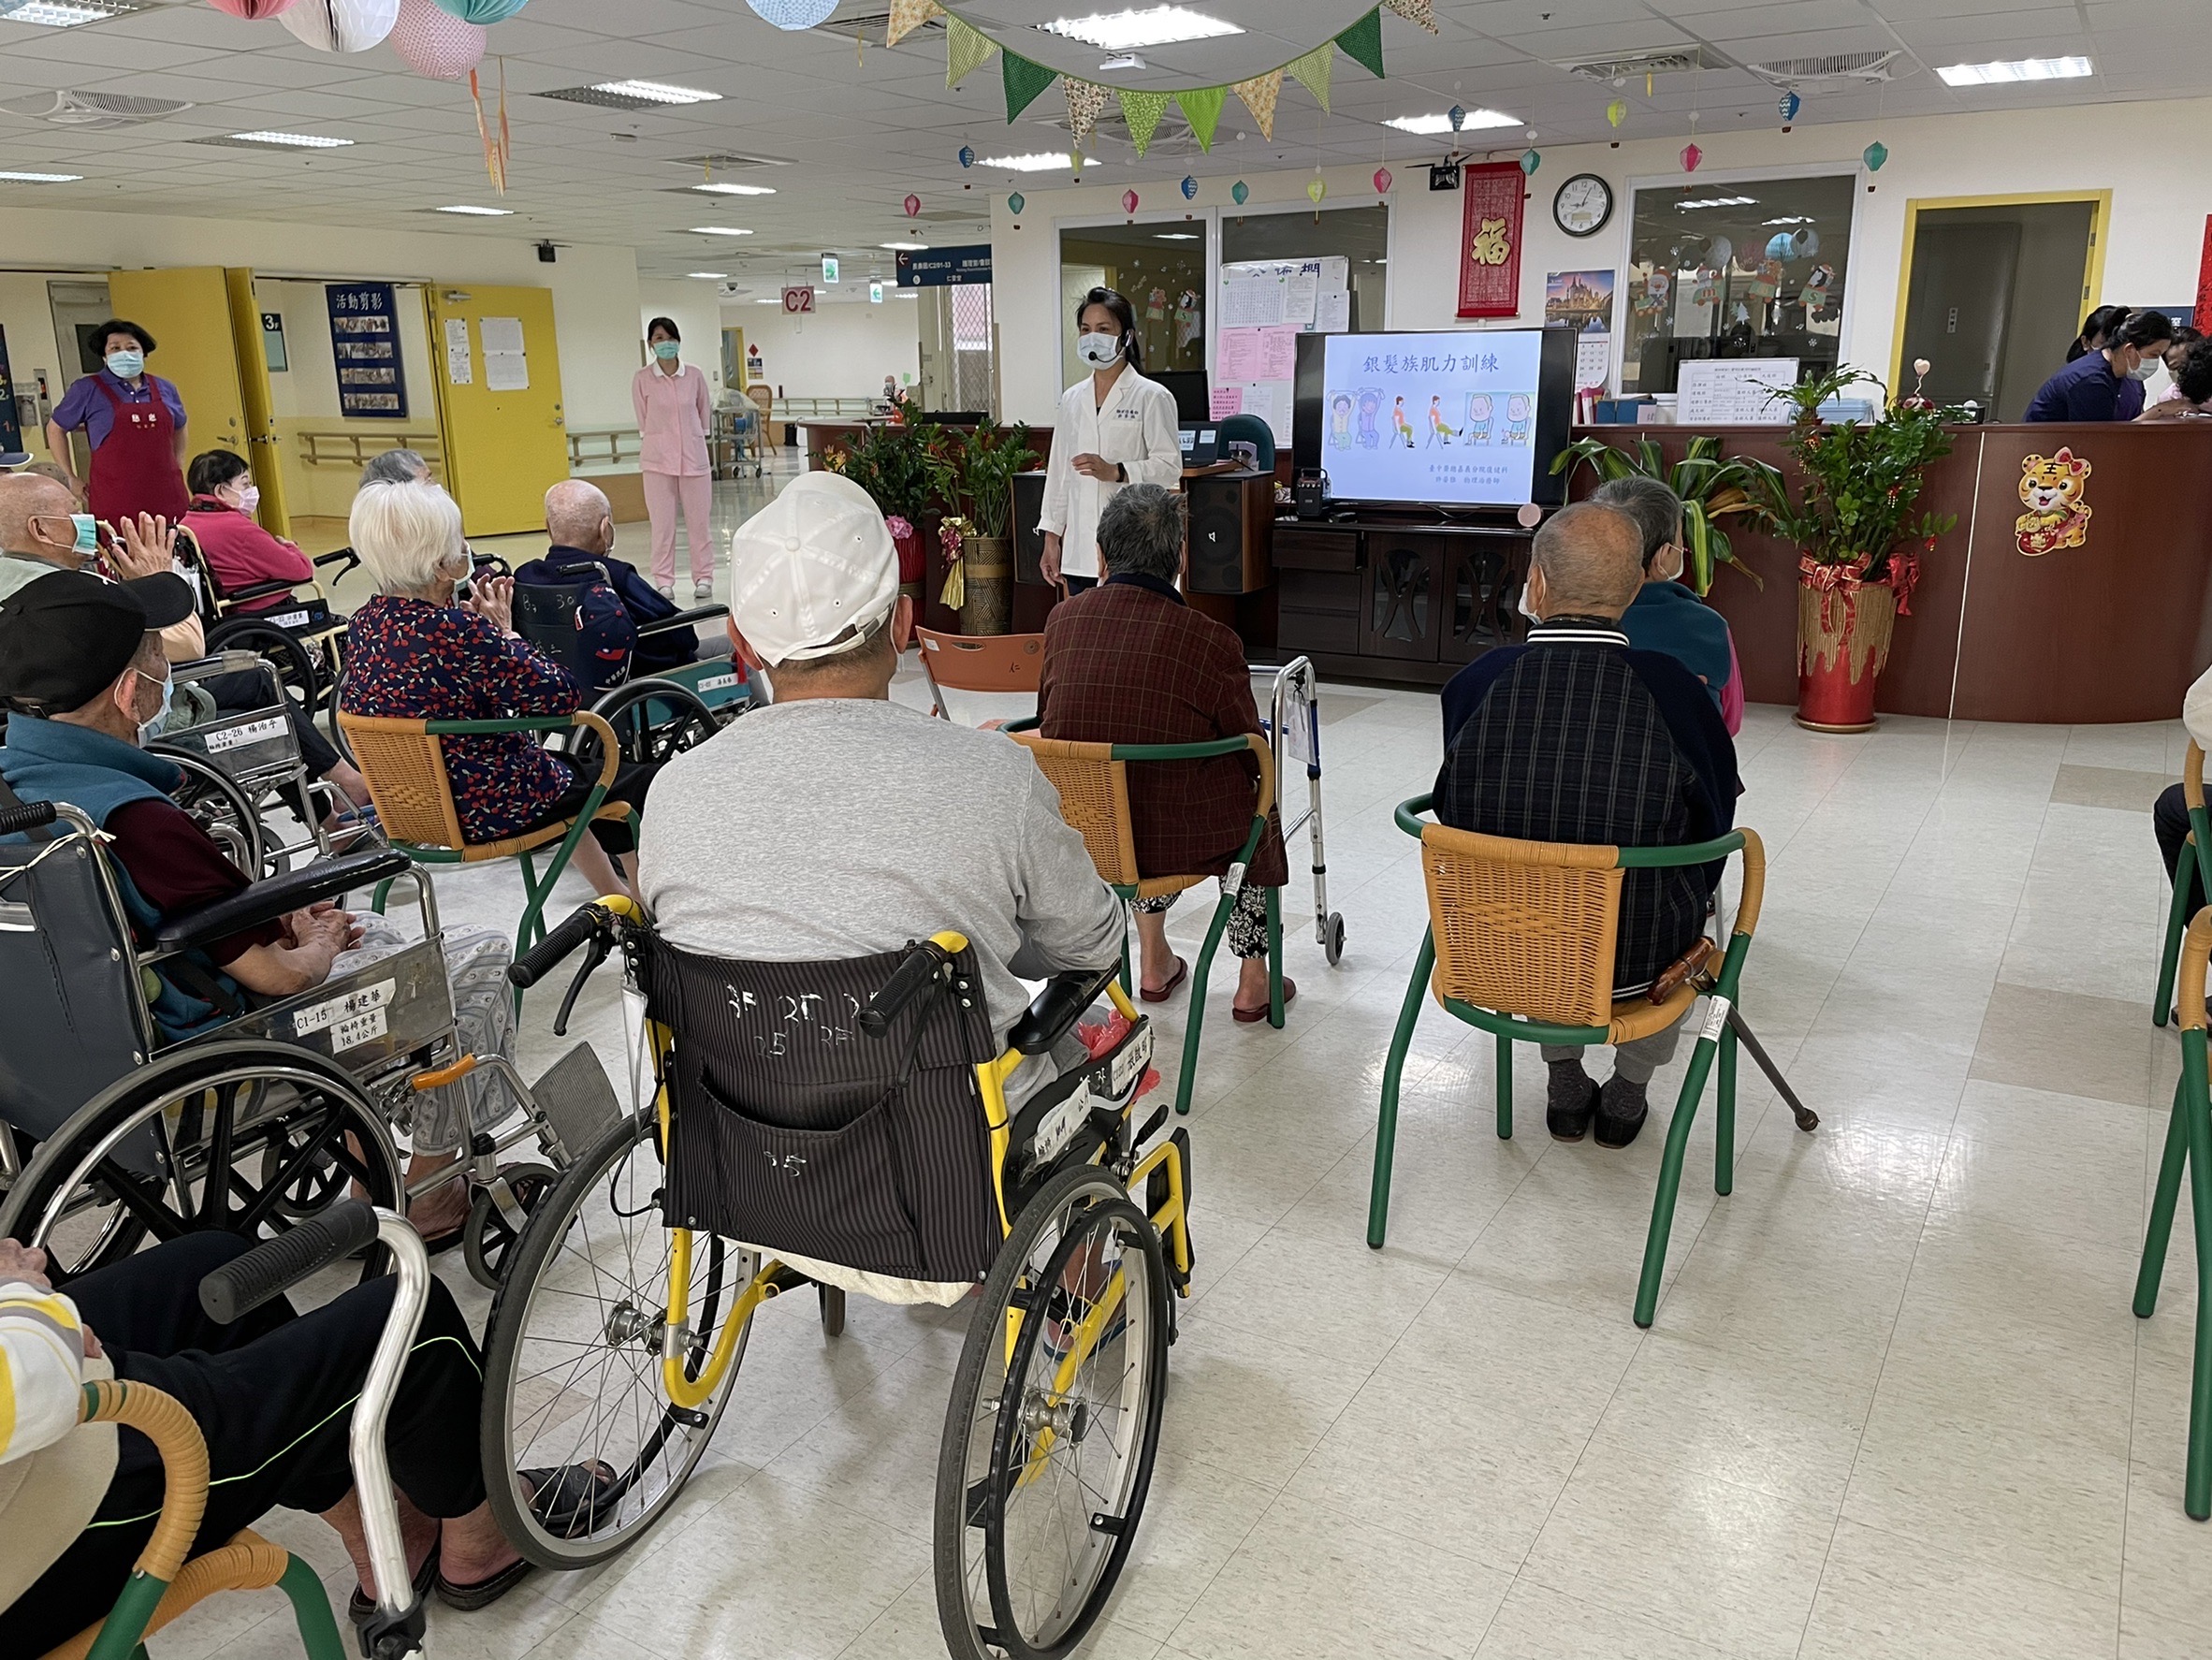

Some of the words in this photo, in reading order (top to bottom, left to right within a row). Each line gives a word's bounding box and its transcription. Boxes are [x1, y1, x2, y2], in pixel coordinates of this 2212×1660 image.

[1471, 217, 1511, 266] 福
[337, 291, 383, 311] 活動剪影
[786, 290, 811, 313] C2
[265, 314, 280, 329] 3F
[1362, 353, 1499, 374] 銀髮族肌力訓練
[216, 727, 243, 741] C2-26
[297, 1010, 327, 1029] C1-15
[341, 1013, 377, 1034] 輪椅重量
